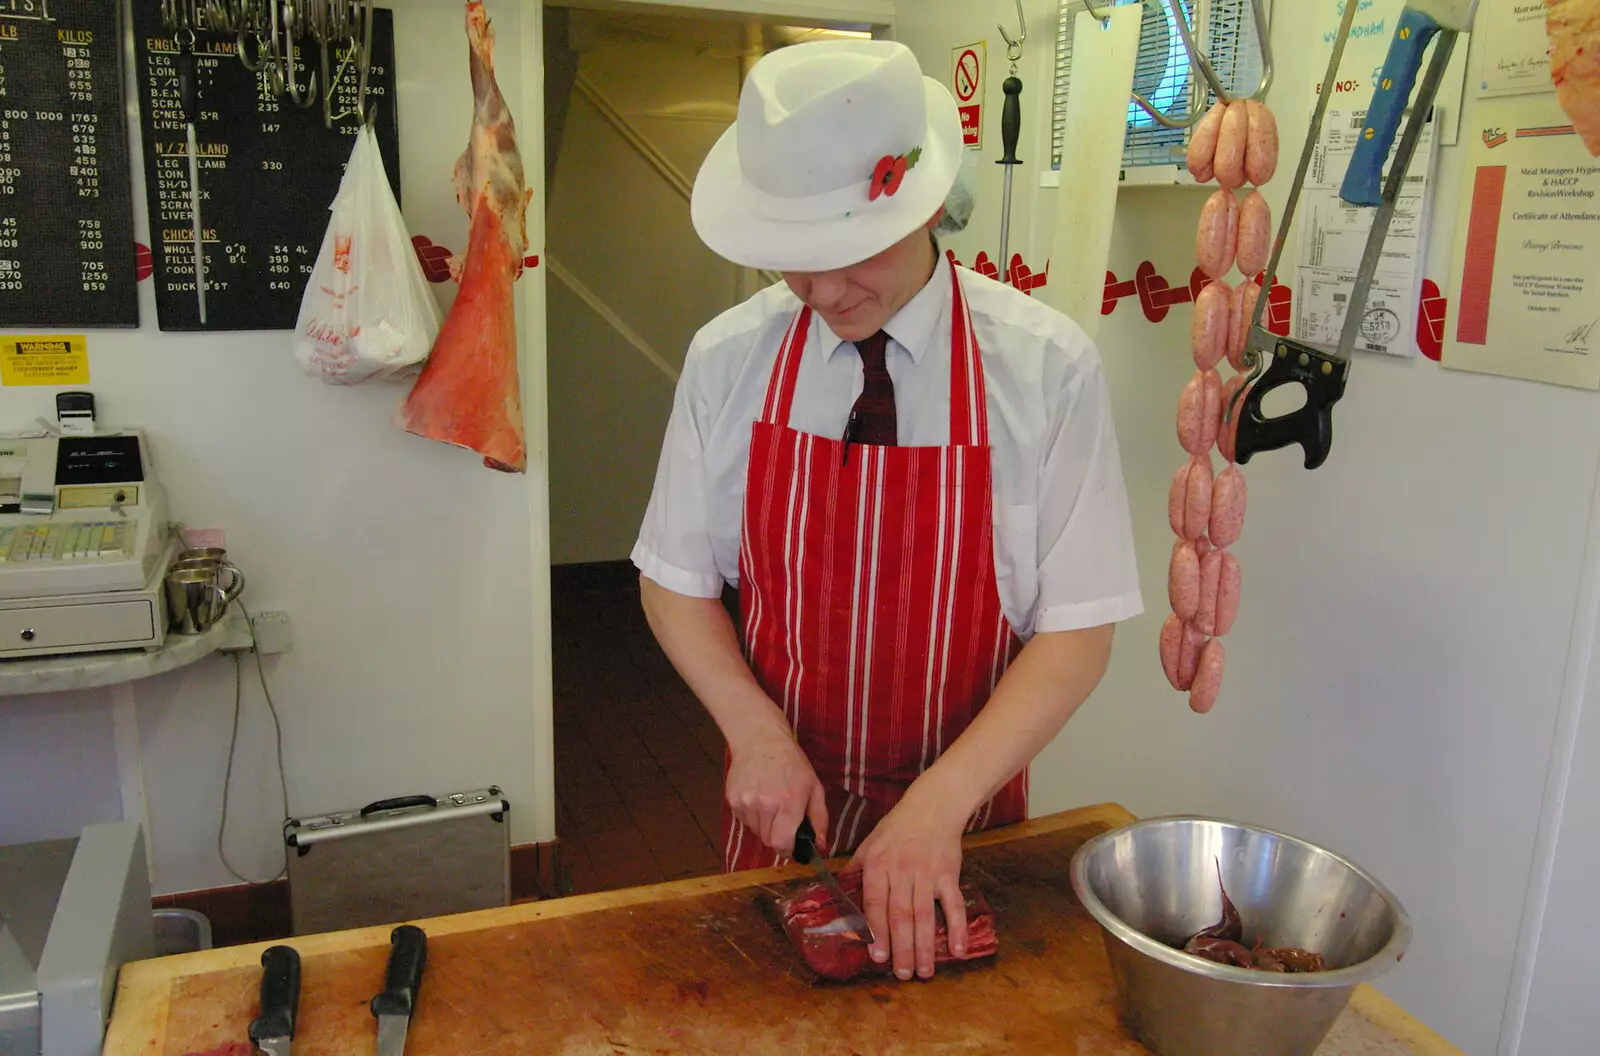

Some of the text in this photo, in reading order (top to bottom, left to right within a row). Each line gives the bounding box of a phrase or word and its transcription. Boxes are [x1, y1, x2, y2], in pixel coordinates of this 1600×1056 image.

[58, 29, 93, 42] KILOS
[148, 56, 171, 65] LEG
[69, 70, 91, 79] 635
[149, 67, 176, 76] LOIN
[70, 92, 93, 100] 758
[258, 103, 280, 112] 235
[4, 110, 28, 119] 800
[71, 113, 98, 122] 1763
[72, 124, 95, 133] 679
[262, 124, 280, 132] 147
[73, 135, 96, 144] 635
[157, 160, 282, 170] LEG LAMB 330
[158, 170, 184, 179] LOIN
[1521, 167, 1538, 176] Meat
[1540, 167, 1575, 177] Managers
[159, 181, 188, 189] SH/D
[1551, 177, 1580, 187] HACCP
[1512, 211, 1548, 220] Certificate
[79, 220, 101, 229] 758
[80, 231, 102, 239] 765
[81, 241, 103, 249] 900
[269, 255, 289, 264] 399
[82, 262, 104, 270] 705
[270, 265, 290, 273] 480
[82, 272, 109, 280] 1256
[168, 282, 197, 291] DUCK
[270, 281, 290, 290] 640
